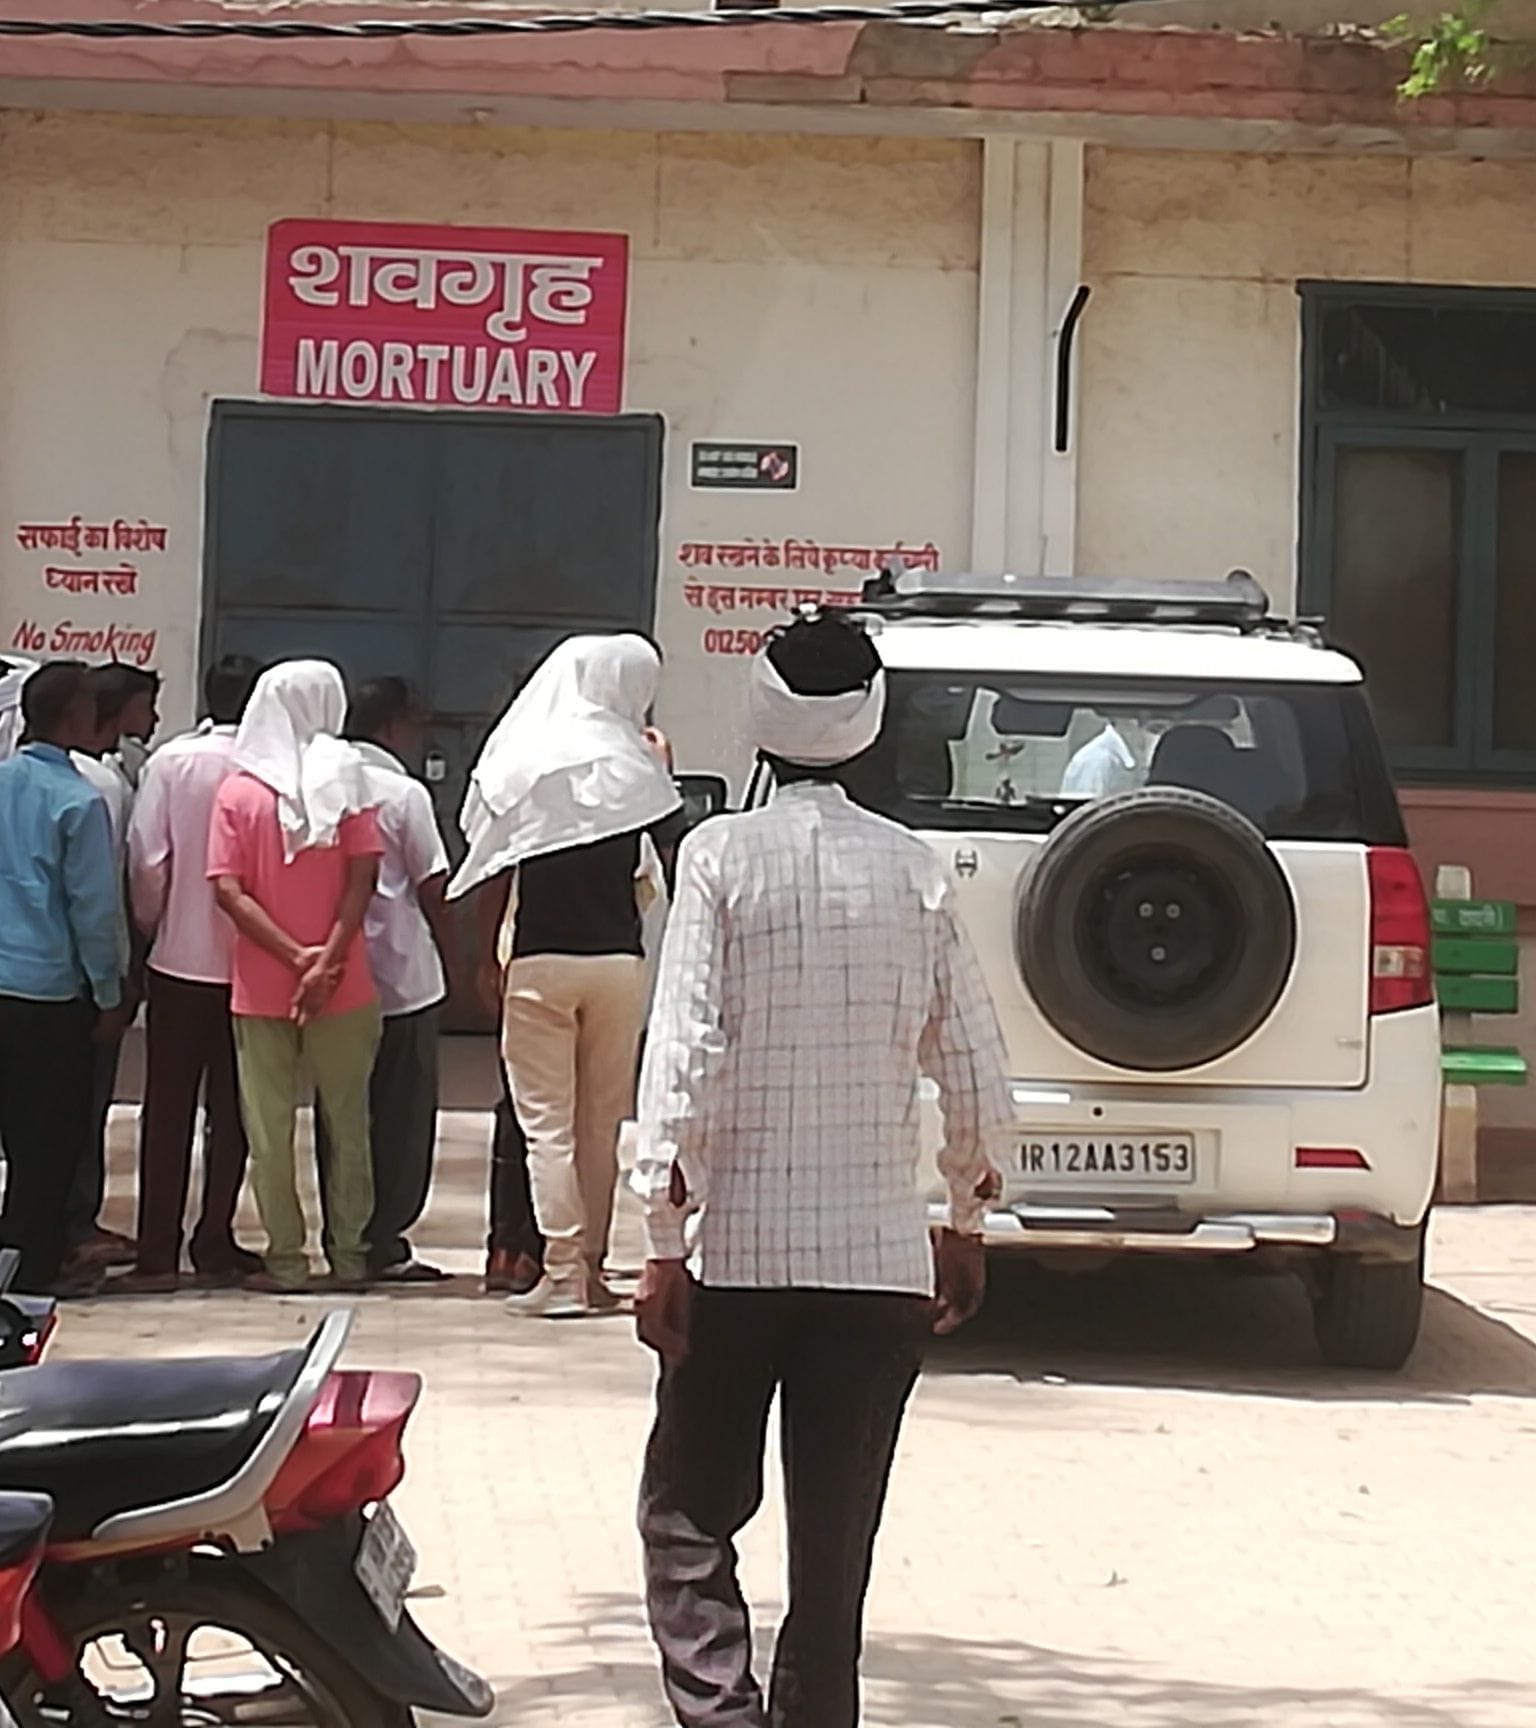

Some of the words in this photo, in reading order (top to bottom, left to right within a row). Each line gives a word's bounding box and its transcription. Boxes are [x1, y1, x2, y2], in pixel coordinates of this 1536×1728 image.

[288, 245, 604, 343] शवगृह
[296, 339, 597, 408] MORTUARY
[16, 515, 82, 557] सफाई
[84, 527, 109, 550] का
[112, 519, 167, 551] विशेष
[678, 543, 713, 567] शव
[763, 538, 780, 567] के
[13, 621, 46, 651] No
[50, 620, 157, 665] Smoking
